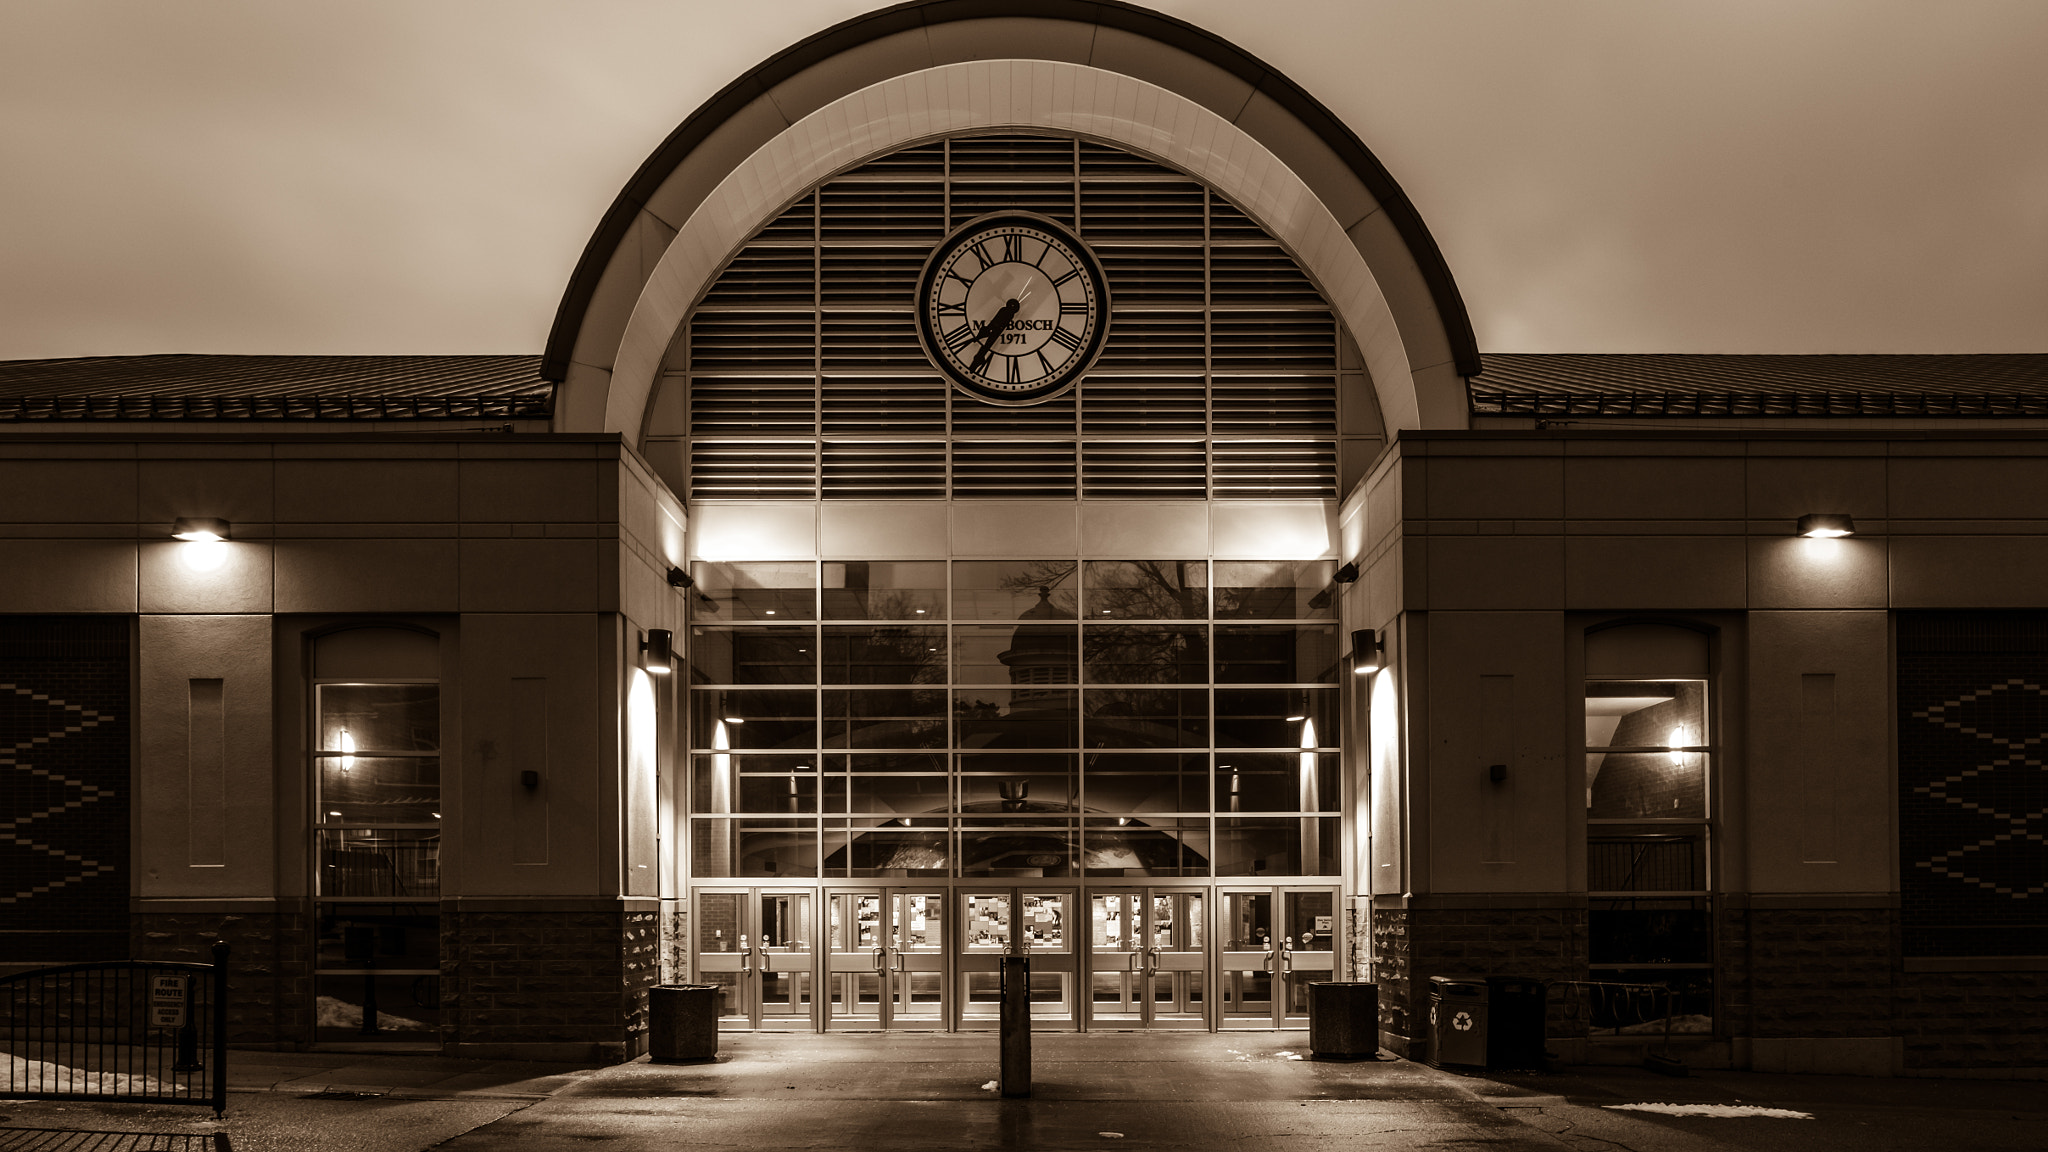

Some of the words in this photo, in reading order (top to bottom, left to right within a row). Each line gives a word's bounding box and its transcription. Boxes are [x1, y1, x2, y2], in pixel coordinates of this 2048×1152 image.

[1006, 319, 1053, 331] BOSCH
[1000, 333, 1027, 345] 1971
[160, 979, 178, 987] FIRE
[155, 988, 183, 997] ROUTE
